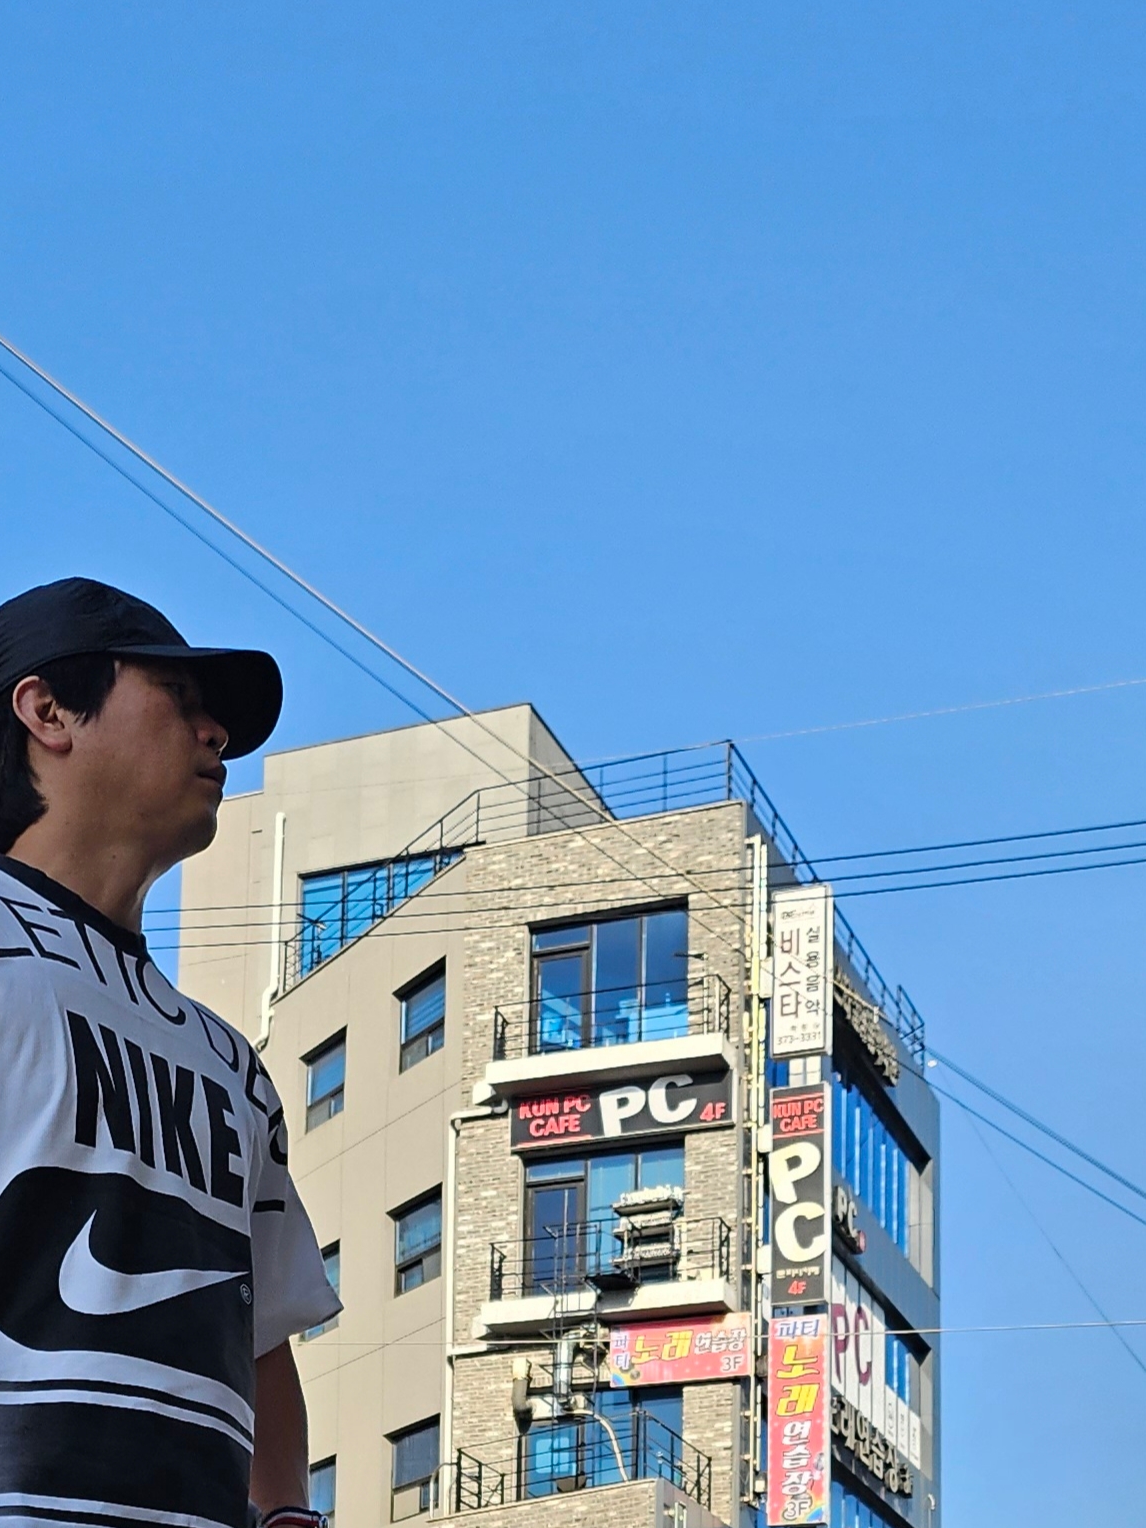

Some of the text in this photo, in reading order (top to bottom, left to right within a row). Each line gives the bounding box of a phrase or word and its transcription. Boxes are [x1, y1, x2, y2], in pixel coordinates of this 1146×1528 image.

[778, 928, 802, 1018] 비스타
[66, 1009, 245, 1208] NIKE
[519, 1093, 591, 1119] KUN PC
[599, 1074, 697, 1137] PC
[700, 1102, 726, 1121] 4F
[773, 1098, 824, 1119] KUN PC
[529, 1114, 581, 1137] CAFE
[780, 1114, 818, 1132] CAFE
[769, 1141, 826, 1263] PC
[788, 1280, 807, 1295] 4F
[775, 1319, 820, 1339] 파티
[721, 1356, 743, 1373] 3F
[783, 1501, 811, 1521] 3F
